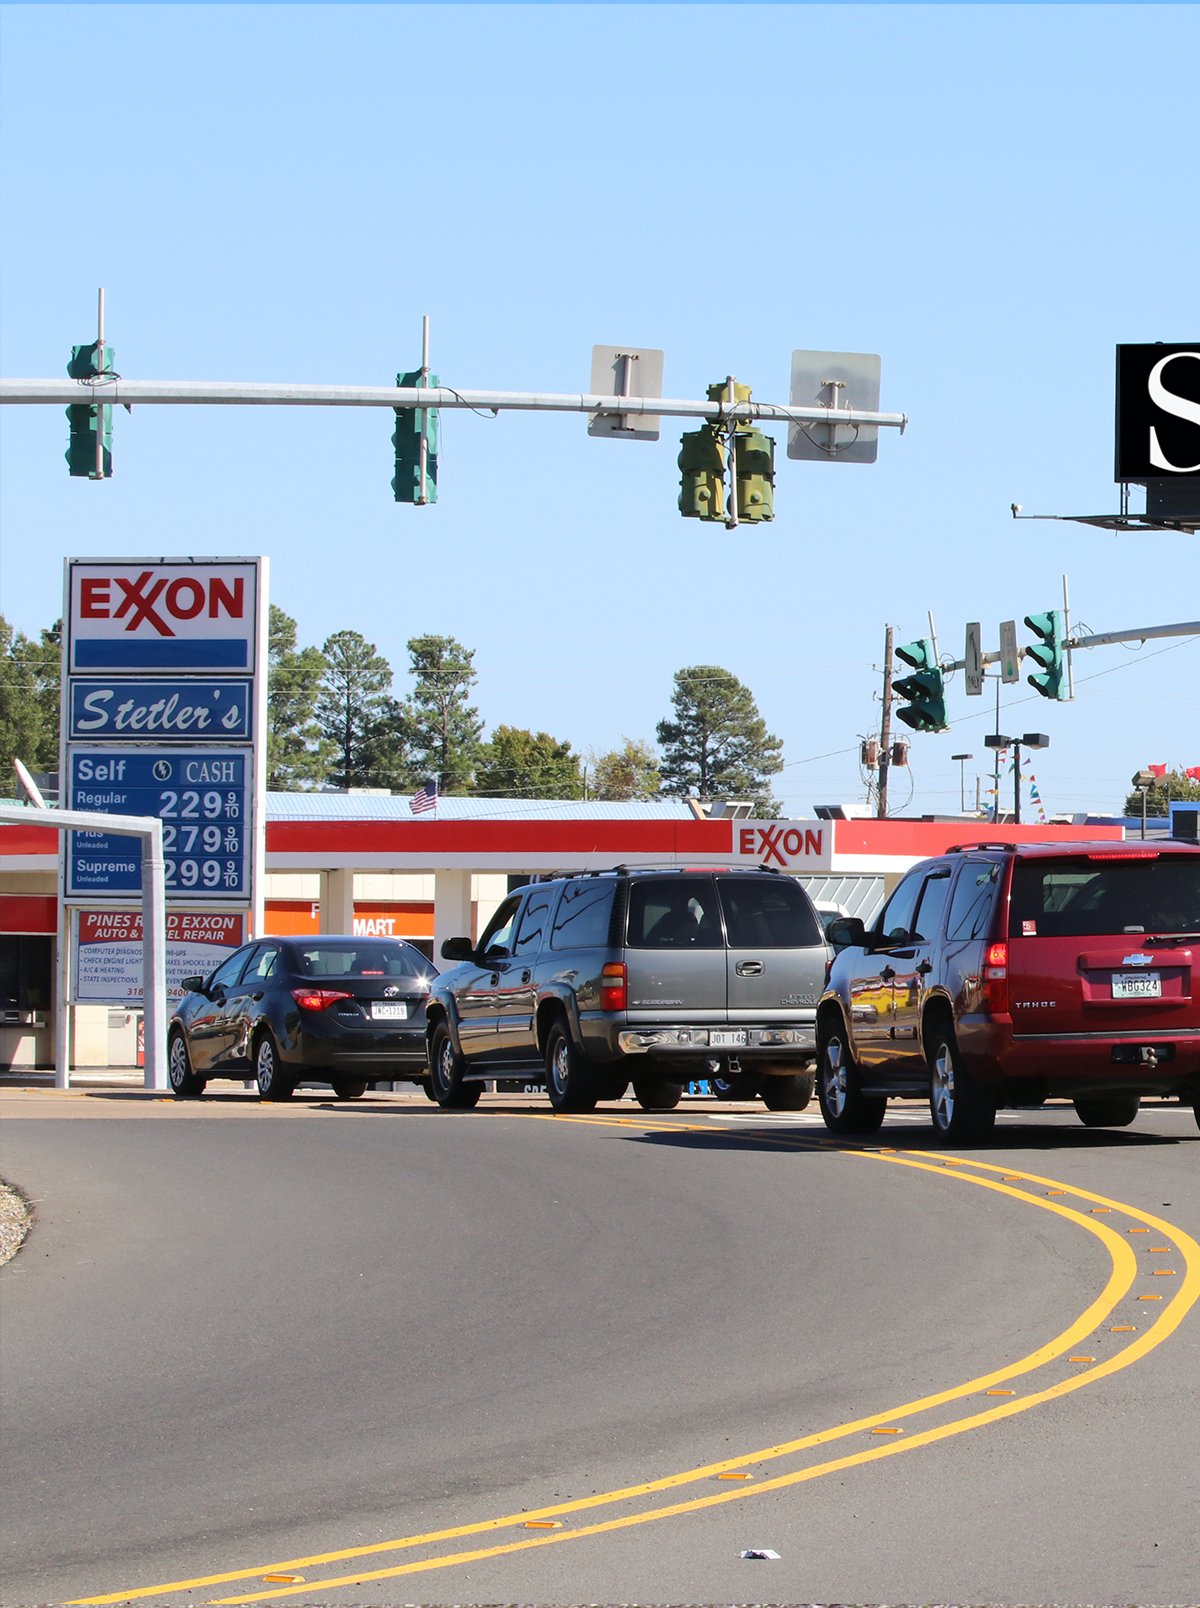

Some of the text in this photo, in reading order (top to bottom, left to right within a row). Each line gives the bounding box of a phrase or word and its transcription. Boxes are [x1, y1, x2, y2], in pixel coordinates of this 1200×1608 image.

[80, 571, 244, 636] EXXON
[77, 690, 242, 730] Stetler's
[78, 759, 235, 783] Self CASH
[77, 791, 222, 818] Regular 229
[163, 826, 221, 853] 279
[740, 825, 823, 866] EXXON
[77, 860, 136, 874] Supreme
[87, 914, 235, 929] PINES RD EXXON
[353, 919, 396, 936] MART
[94, 929, 128, 938] AUTO
[129, 929, 138, 938] &
[183, 931, 225, 940] REPAIR
[83, 947, 115, 955] COMPUTER
[100, 976, 138, 984] INSPECTIONS
[1121, 980, 1158, 992] WBG324
